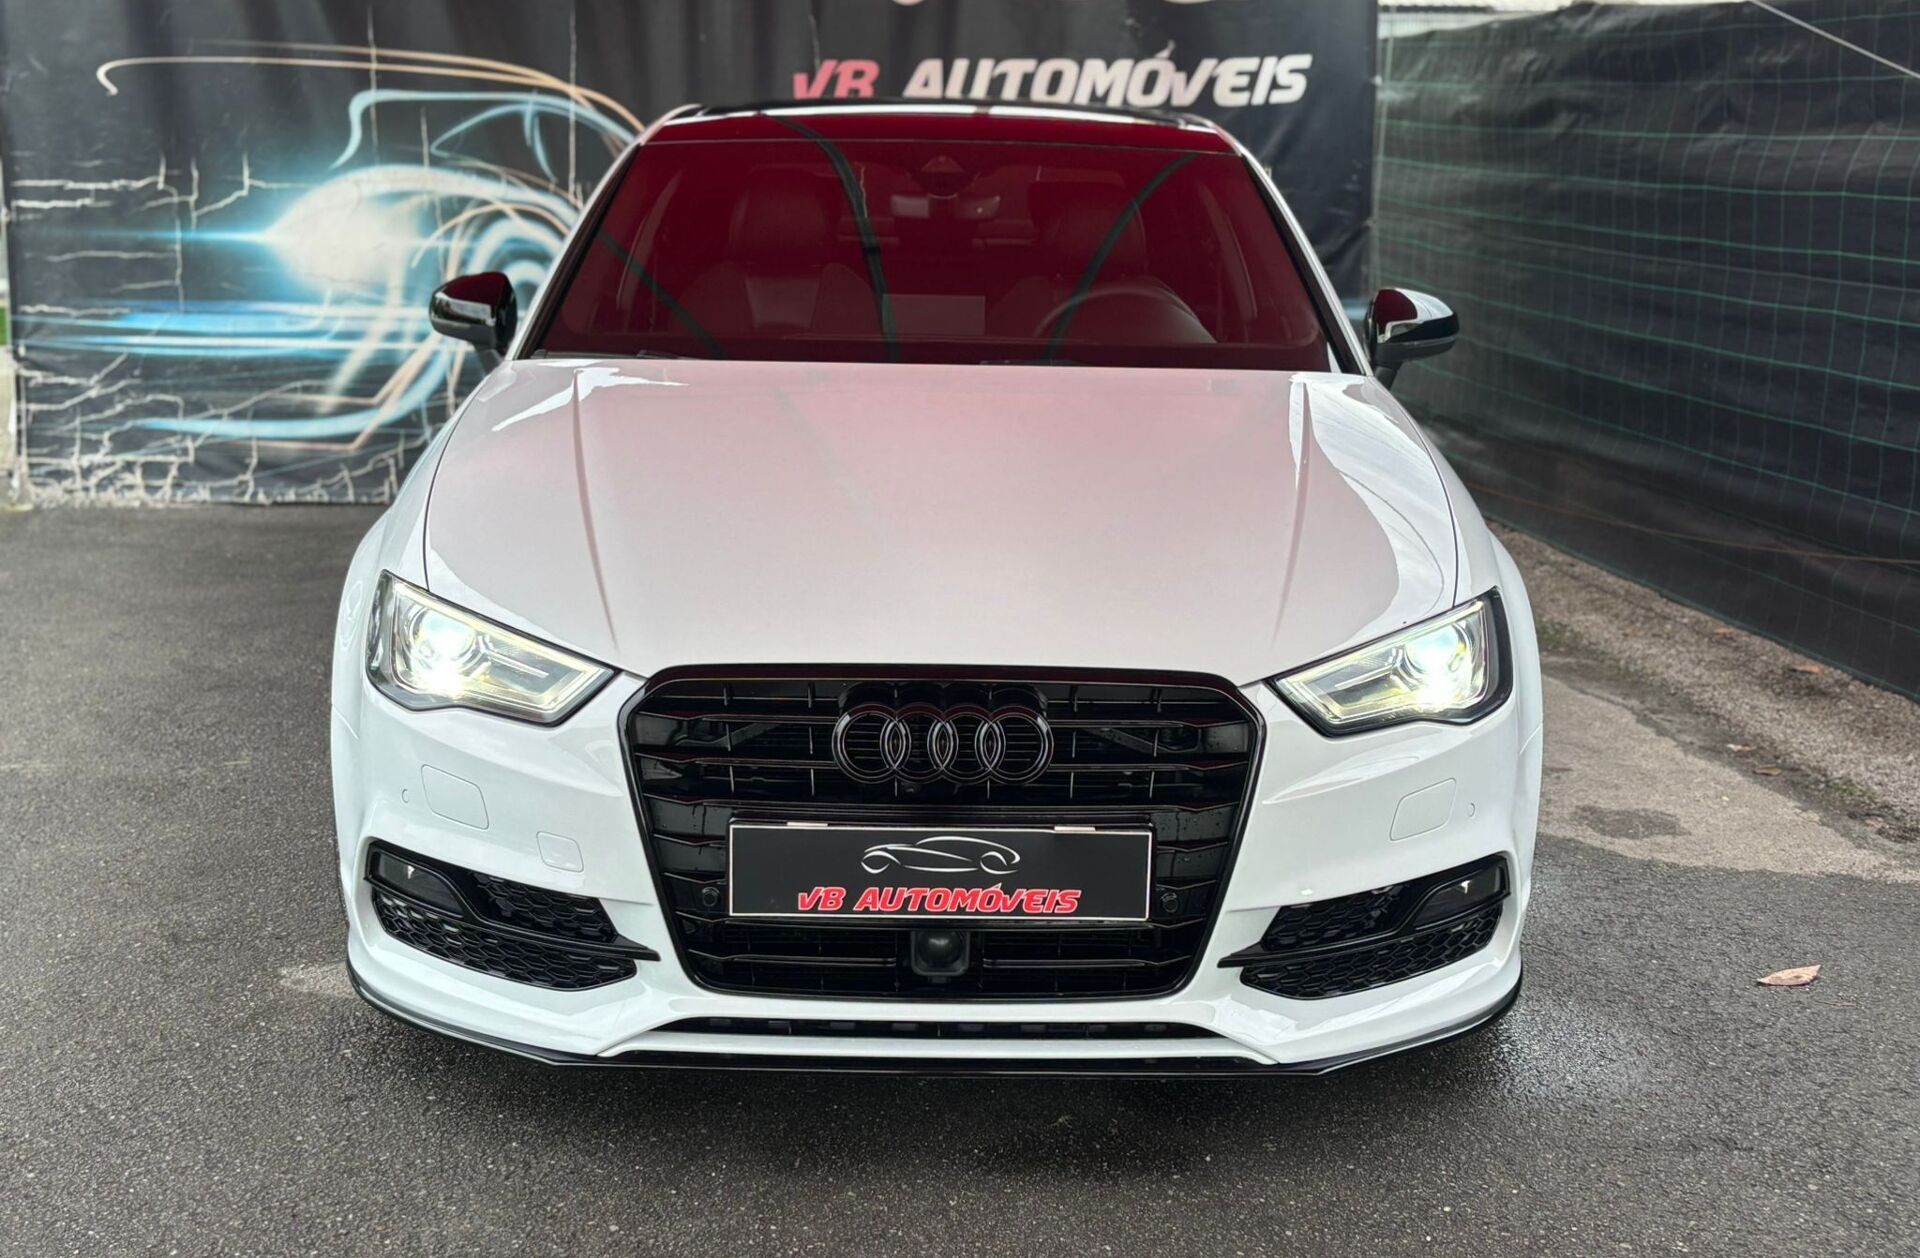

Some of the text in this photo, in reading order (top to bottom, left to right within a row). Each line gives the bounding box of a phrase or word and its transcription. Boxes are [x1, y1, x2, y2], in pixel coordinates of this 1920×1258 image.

[902, 41, 1313, 106] AUTOMÓVEIS
[798, 884, 1081, 913] VB AUTOMÓVEIS
